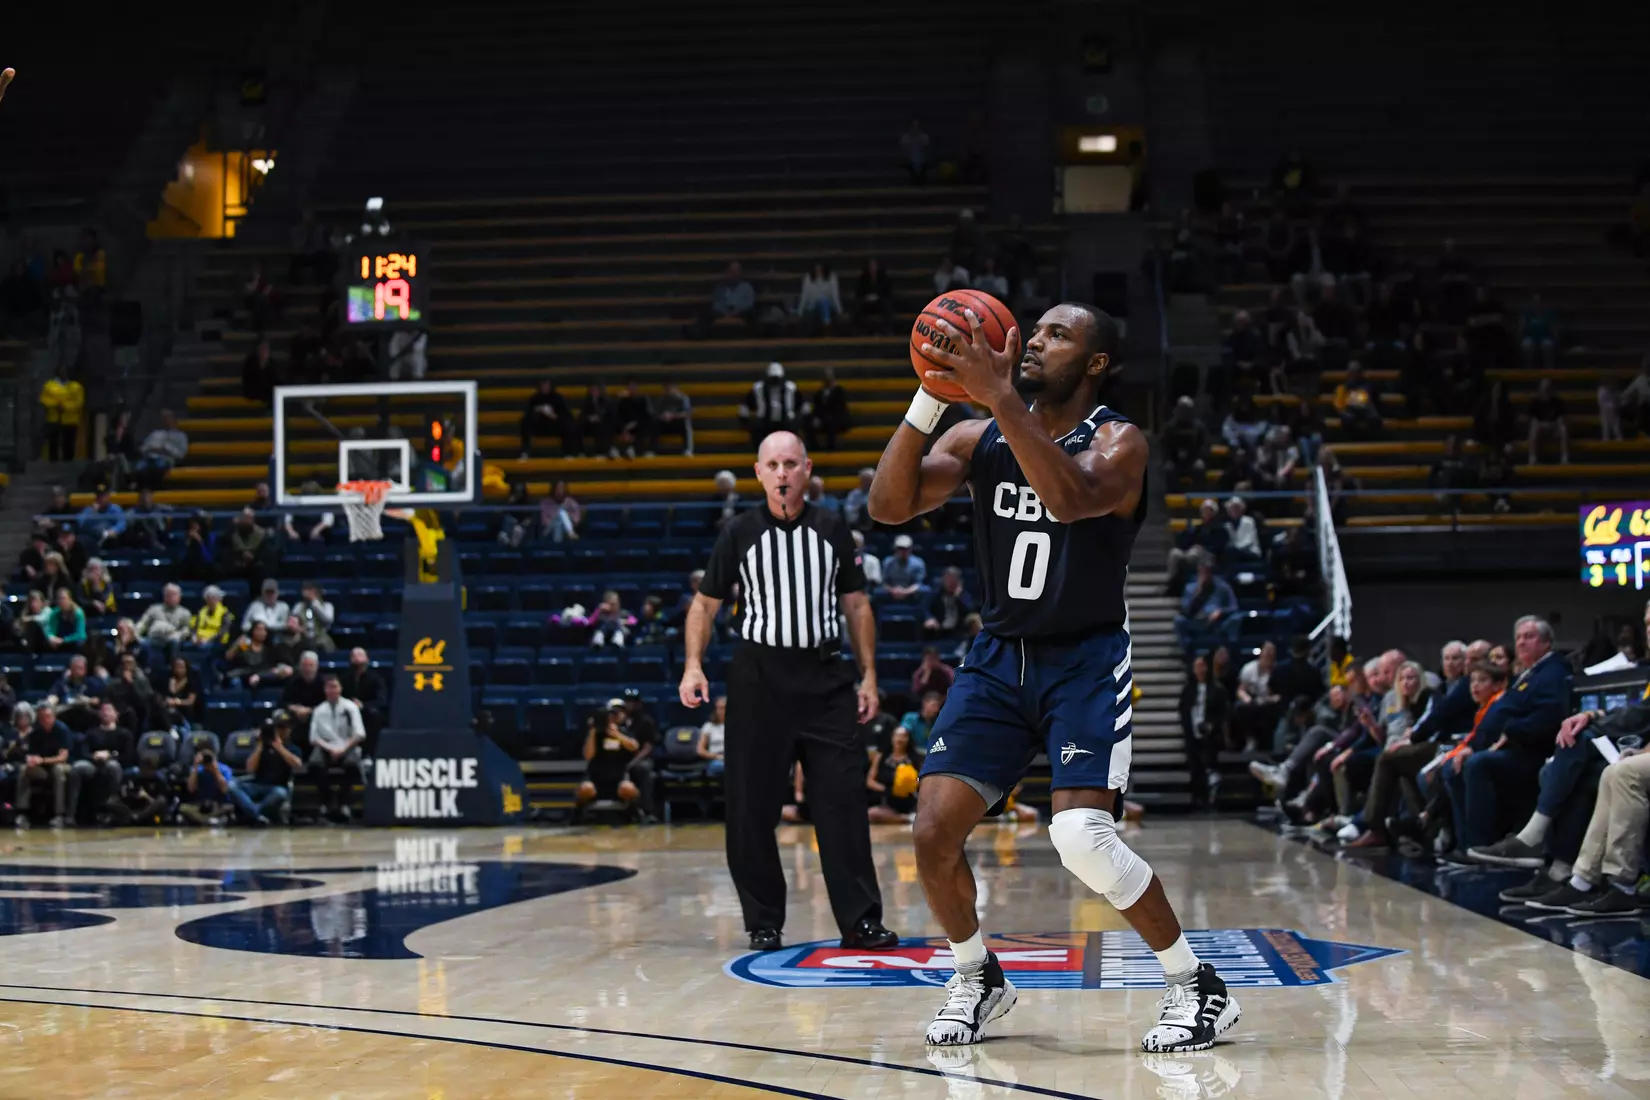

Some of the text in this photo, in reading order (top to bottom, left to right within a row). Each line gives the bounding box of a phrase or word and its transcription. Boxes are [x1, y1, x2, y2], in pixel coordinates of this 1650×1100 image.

[361, 253, 417, 279] 11:24
[374, 279, 410, 320] 19
[1008, 531, 1051, 600] 0
[412, 637, 446, 665] Cal
[375, 758, 478, 788] MUSCLE
[394, 789, 459, 818] MILK
